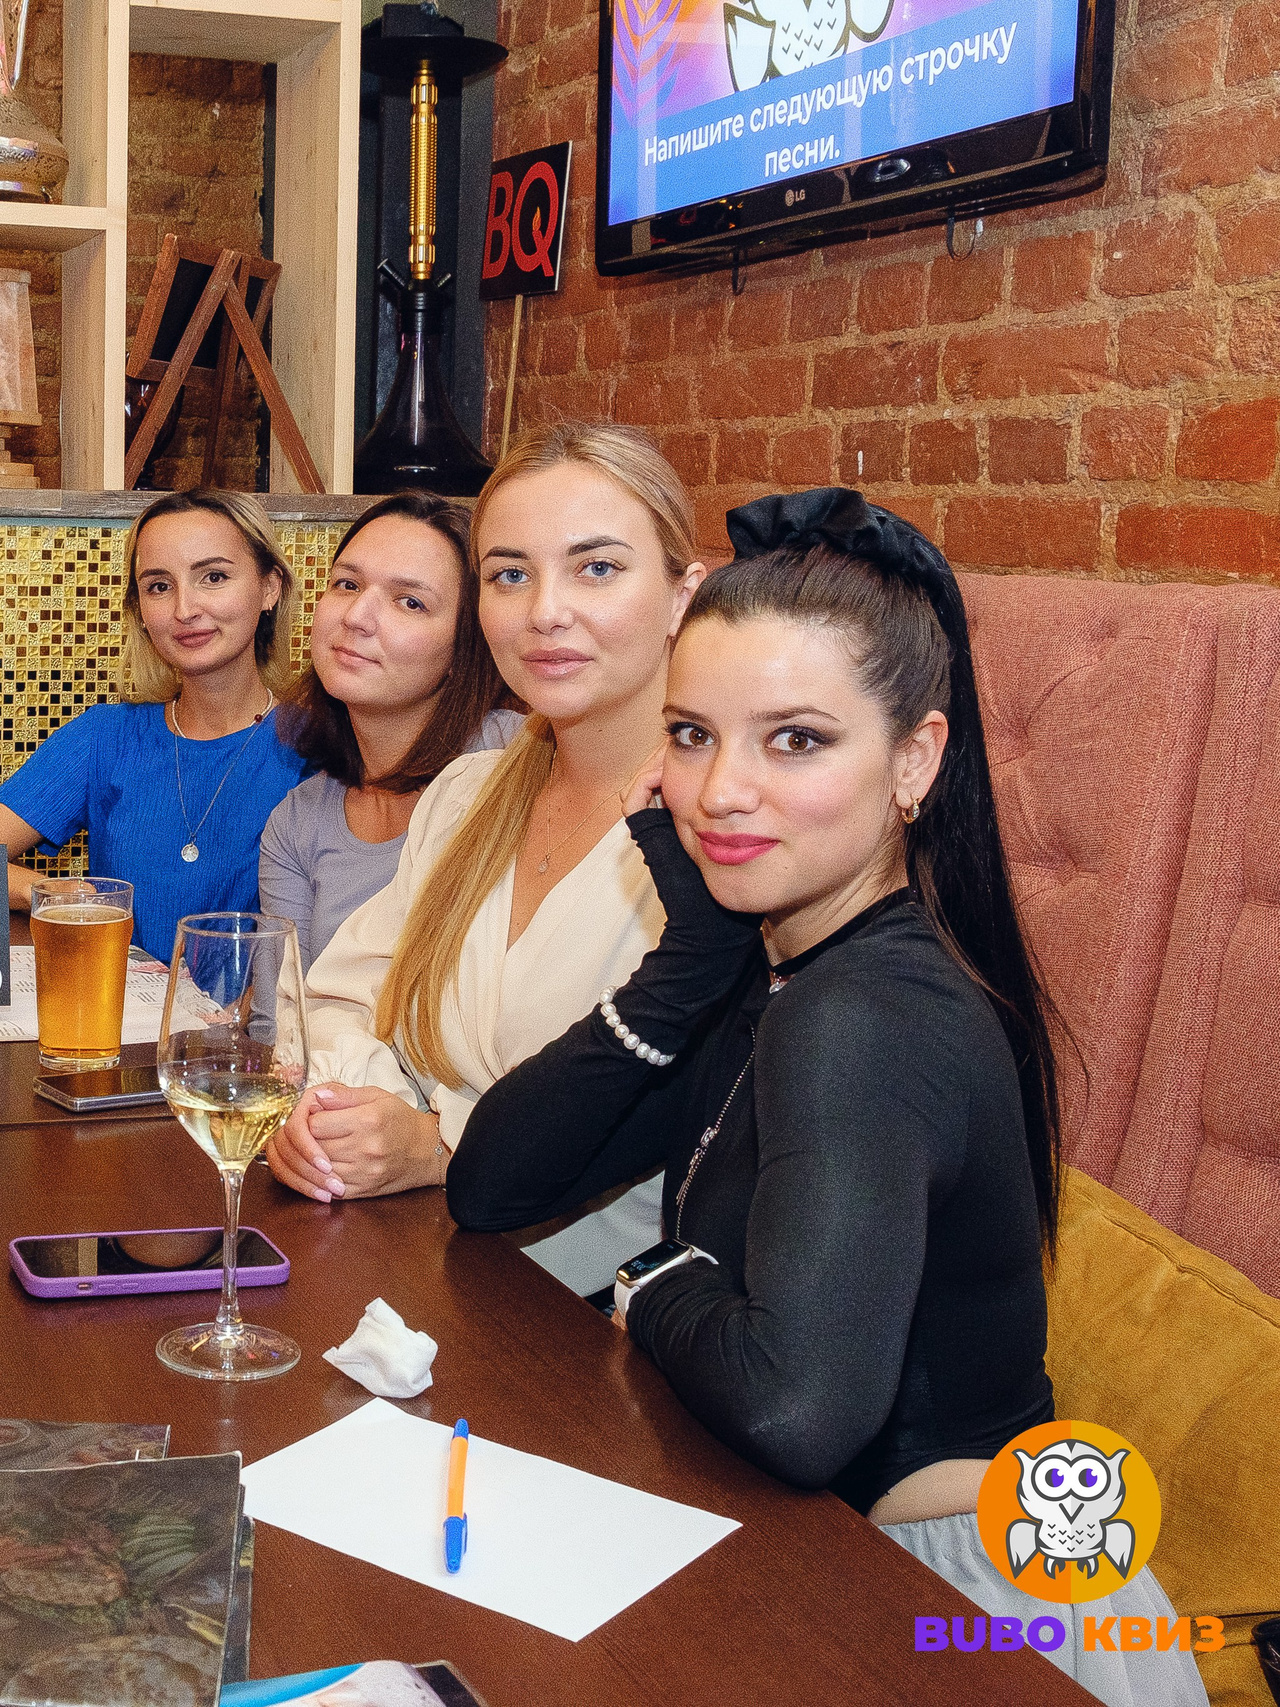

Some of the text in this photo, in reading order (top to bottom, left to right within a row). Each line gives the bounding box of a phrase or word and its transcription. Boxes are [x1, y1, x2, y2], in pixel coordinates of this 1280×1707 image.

[645, 21, 1018, 166] Напишите следующую строчку
[764, 134, 841, 177] песни.
[482, 161, 559, 279] BQ
